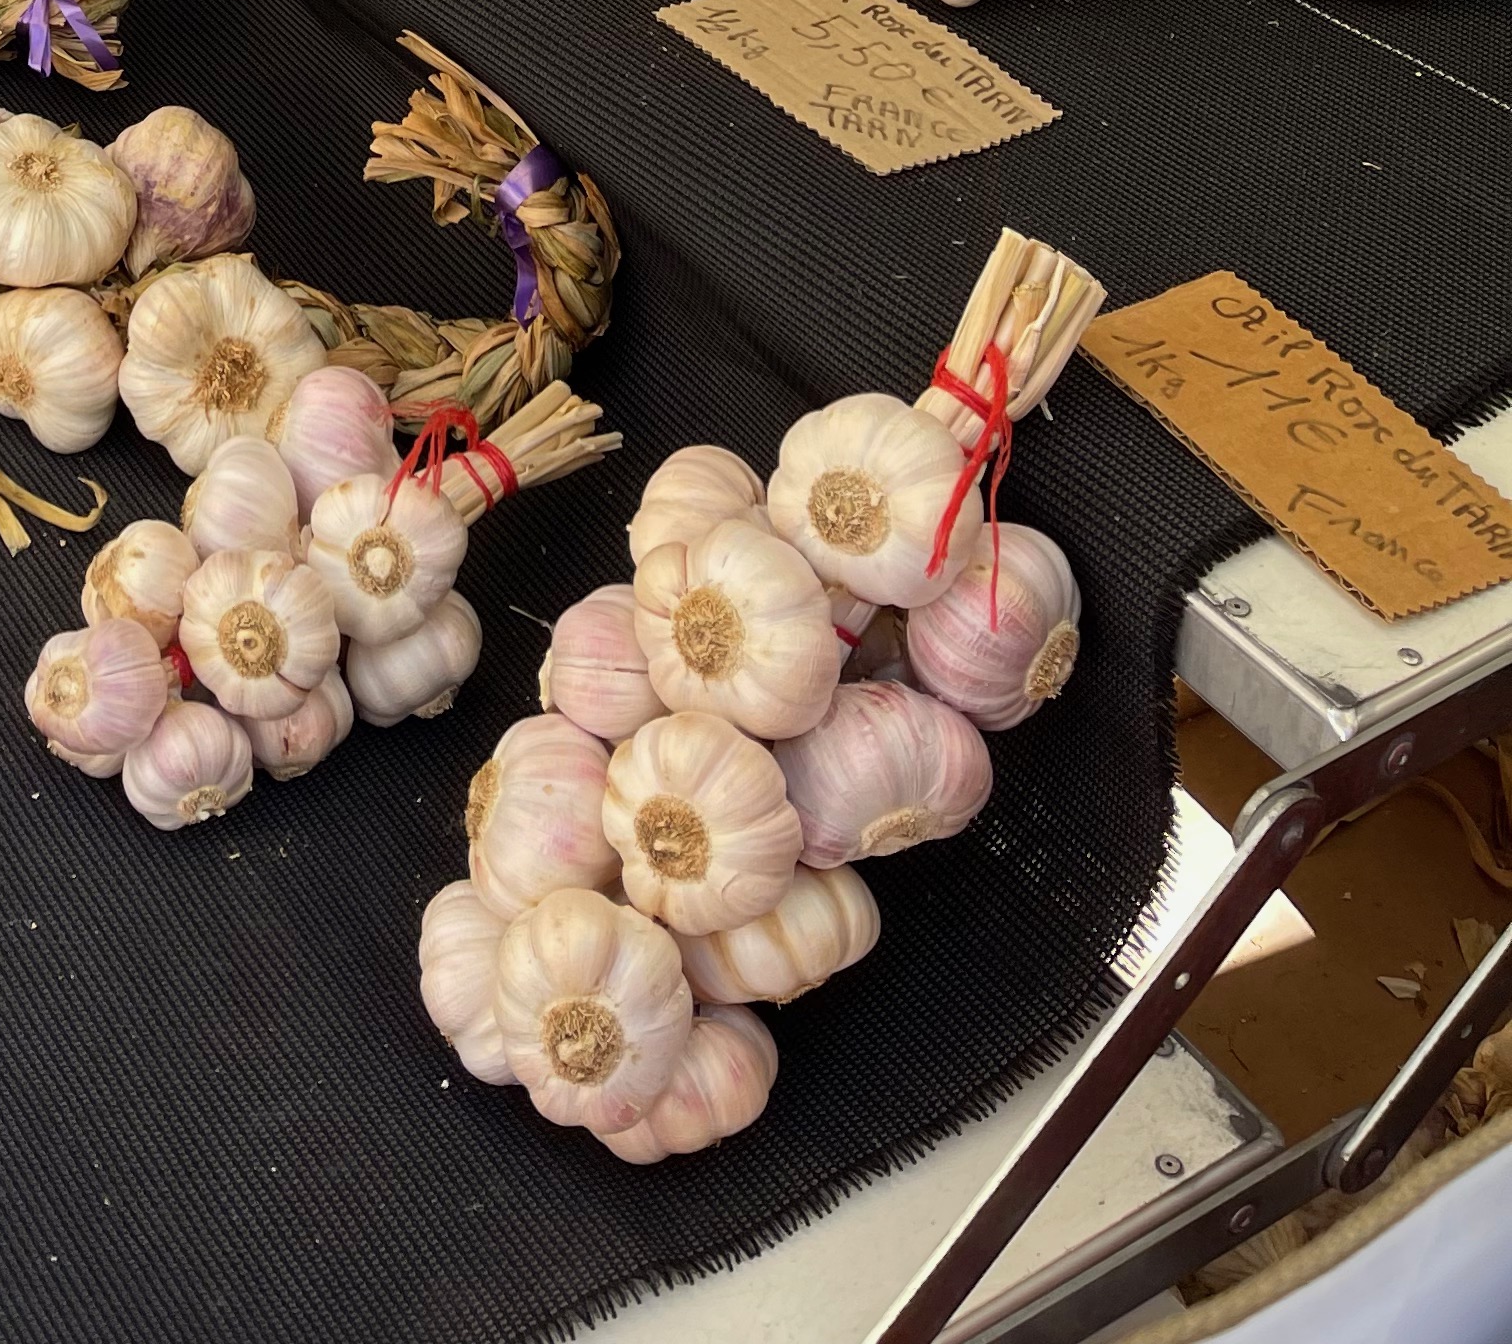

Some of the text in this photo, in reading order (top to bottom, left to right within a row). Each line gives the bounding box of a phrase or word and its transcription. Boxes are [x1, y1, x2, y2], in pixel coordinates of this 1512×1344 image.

[912, 40, 956, 68] du
[953, 56, 1039, 126] TARN
[808, 99, 925, 149] TARN
[821, 82, 977, 144] FRANCE
[1392, 446, 1441, 488] du
